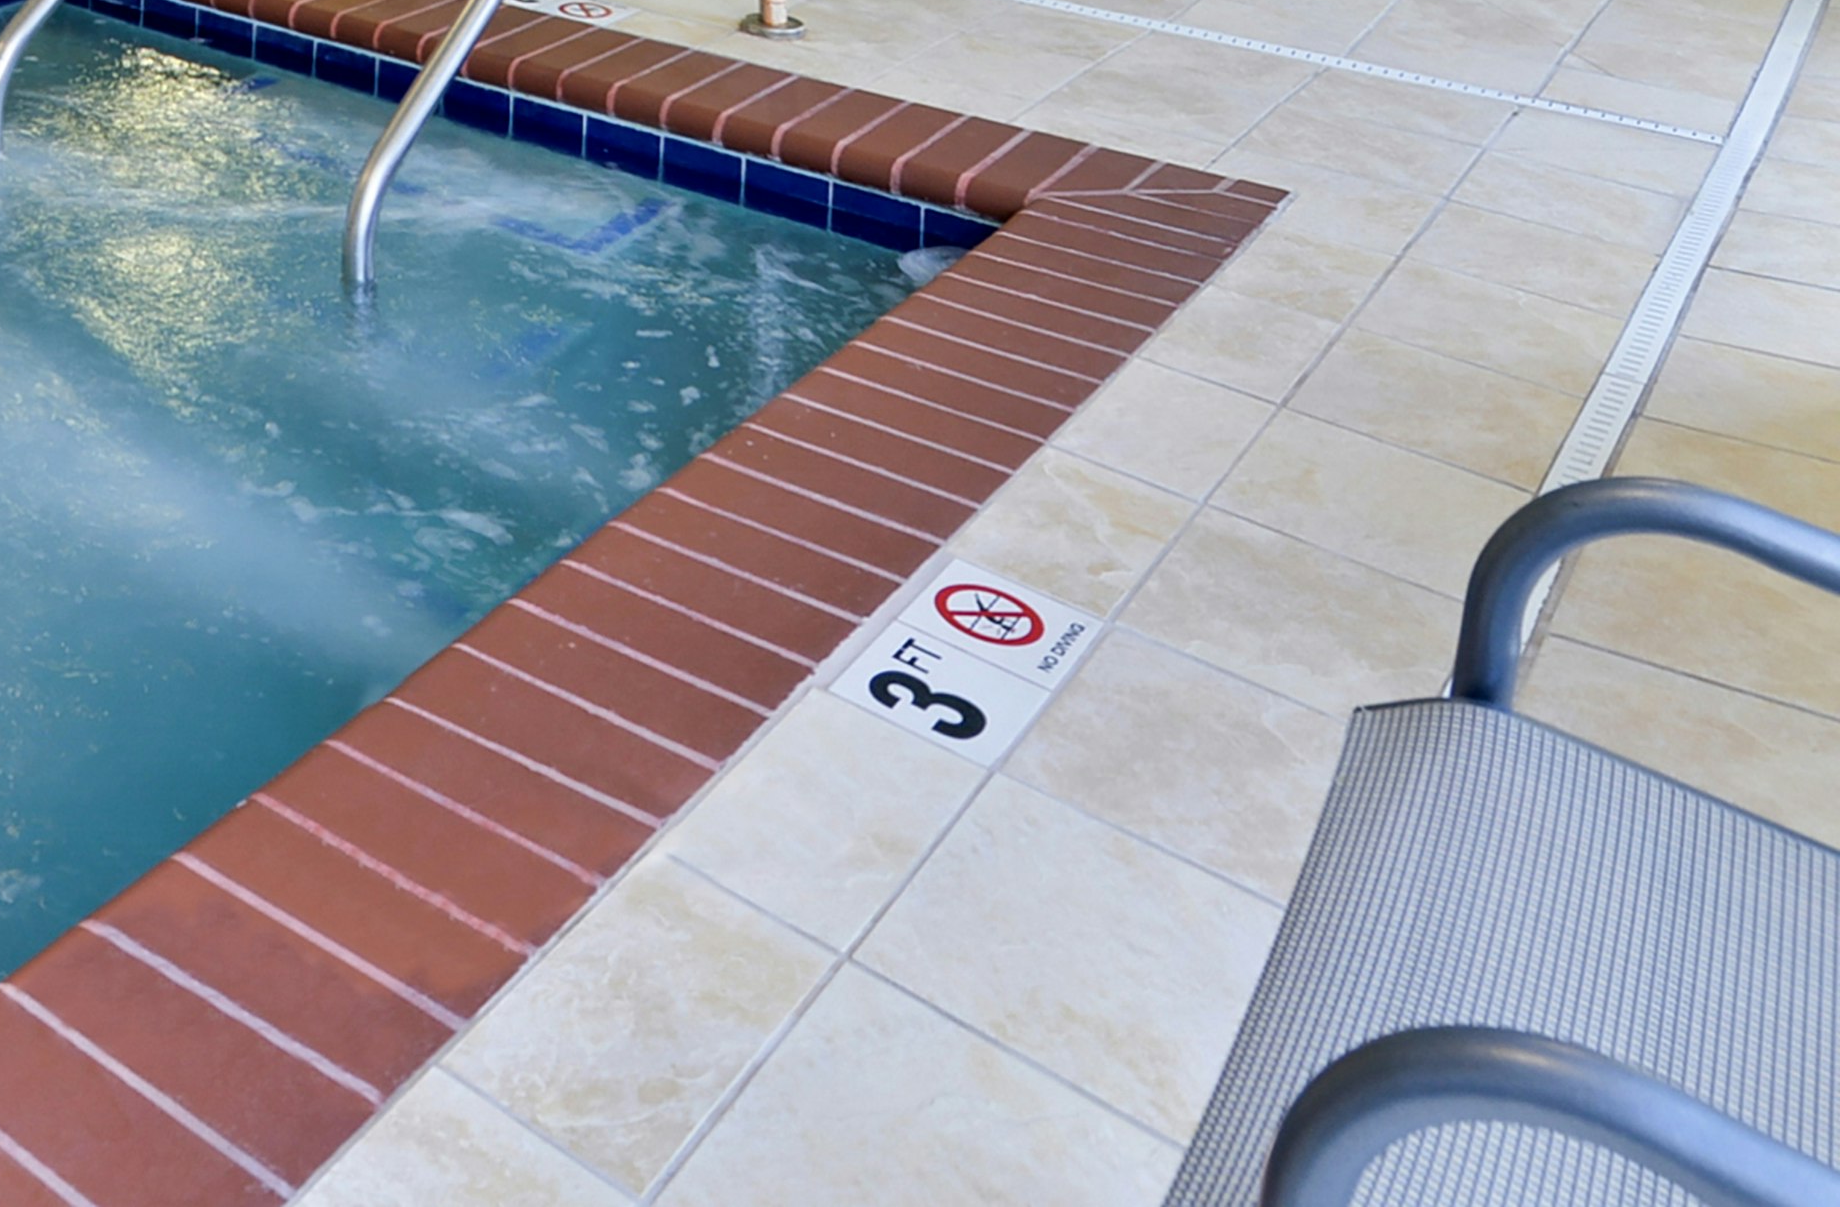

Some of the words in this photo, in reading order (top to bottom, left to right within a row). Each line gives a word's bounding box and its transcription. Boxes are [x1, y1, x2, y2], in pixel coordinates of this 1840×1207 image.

[891, 637, 943, 675] FT
[1036, 654, 1059, 674] NO
[1050, 622, 1086, 657] DIVING
[868, 670, 988, 741] 3
